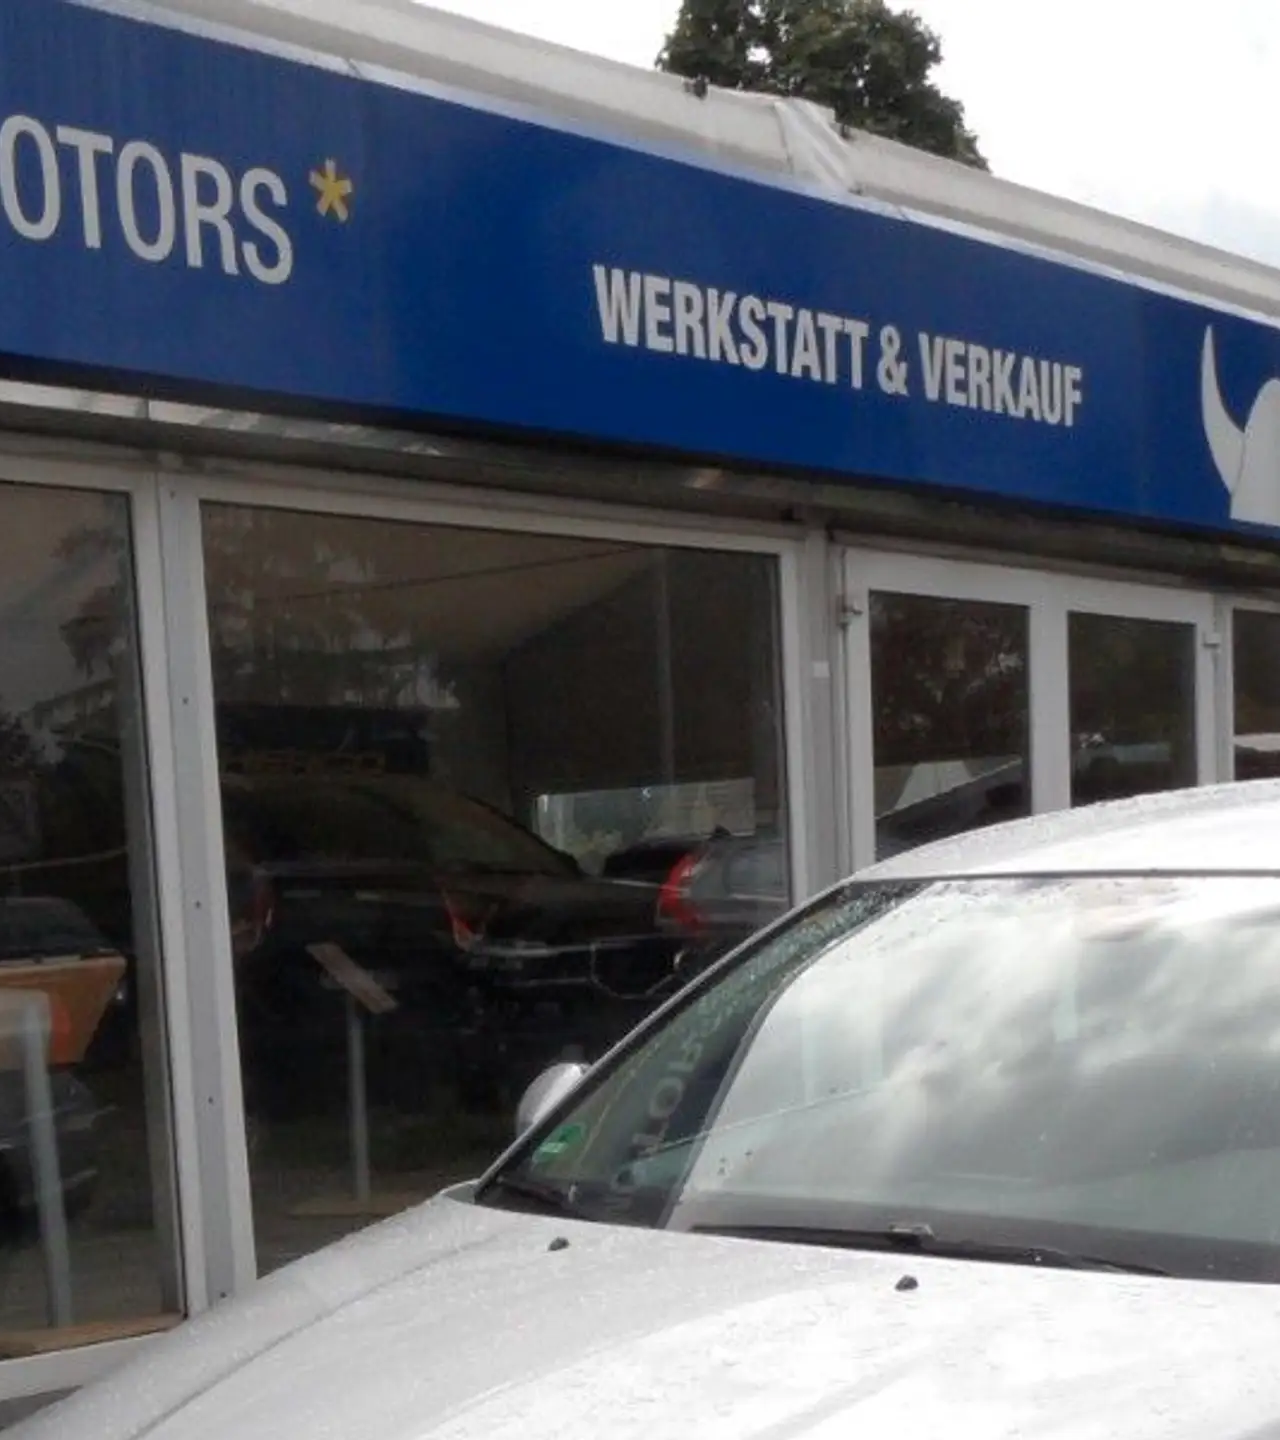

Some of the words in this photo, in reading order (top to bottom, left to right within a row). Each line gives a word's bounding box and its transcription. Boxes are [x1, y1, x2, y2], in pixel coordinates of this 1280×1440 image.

[593, 264, 868, 390] WERKSTATT
[877, 325, 908, 396] &
[919, 331, 1082, 426] VERKAUF
